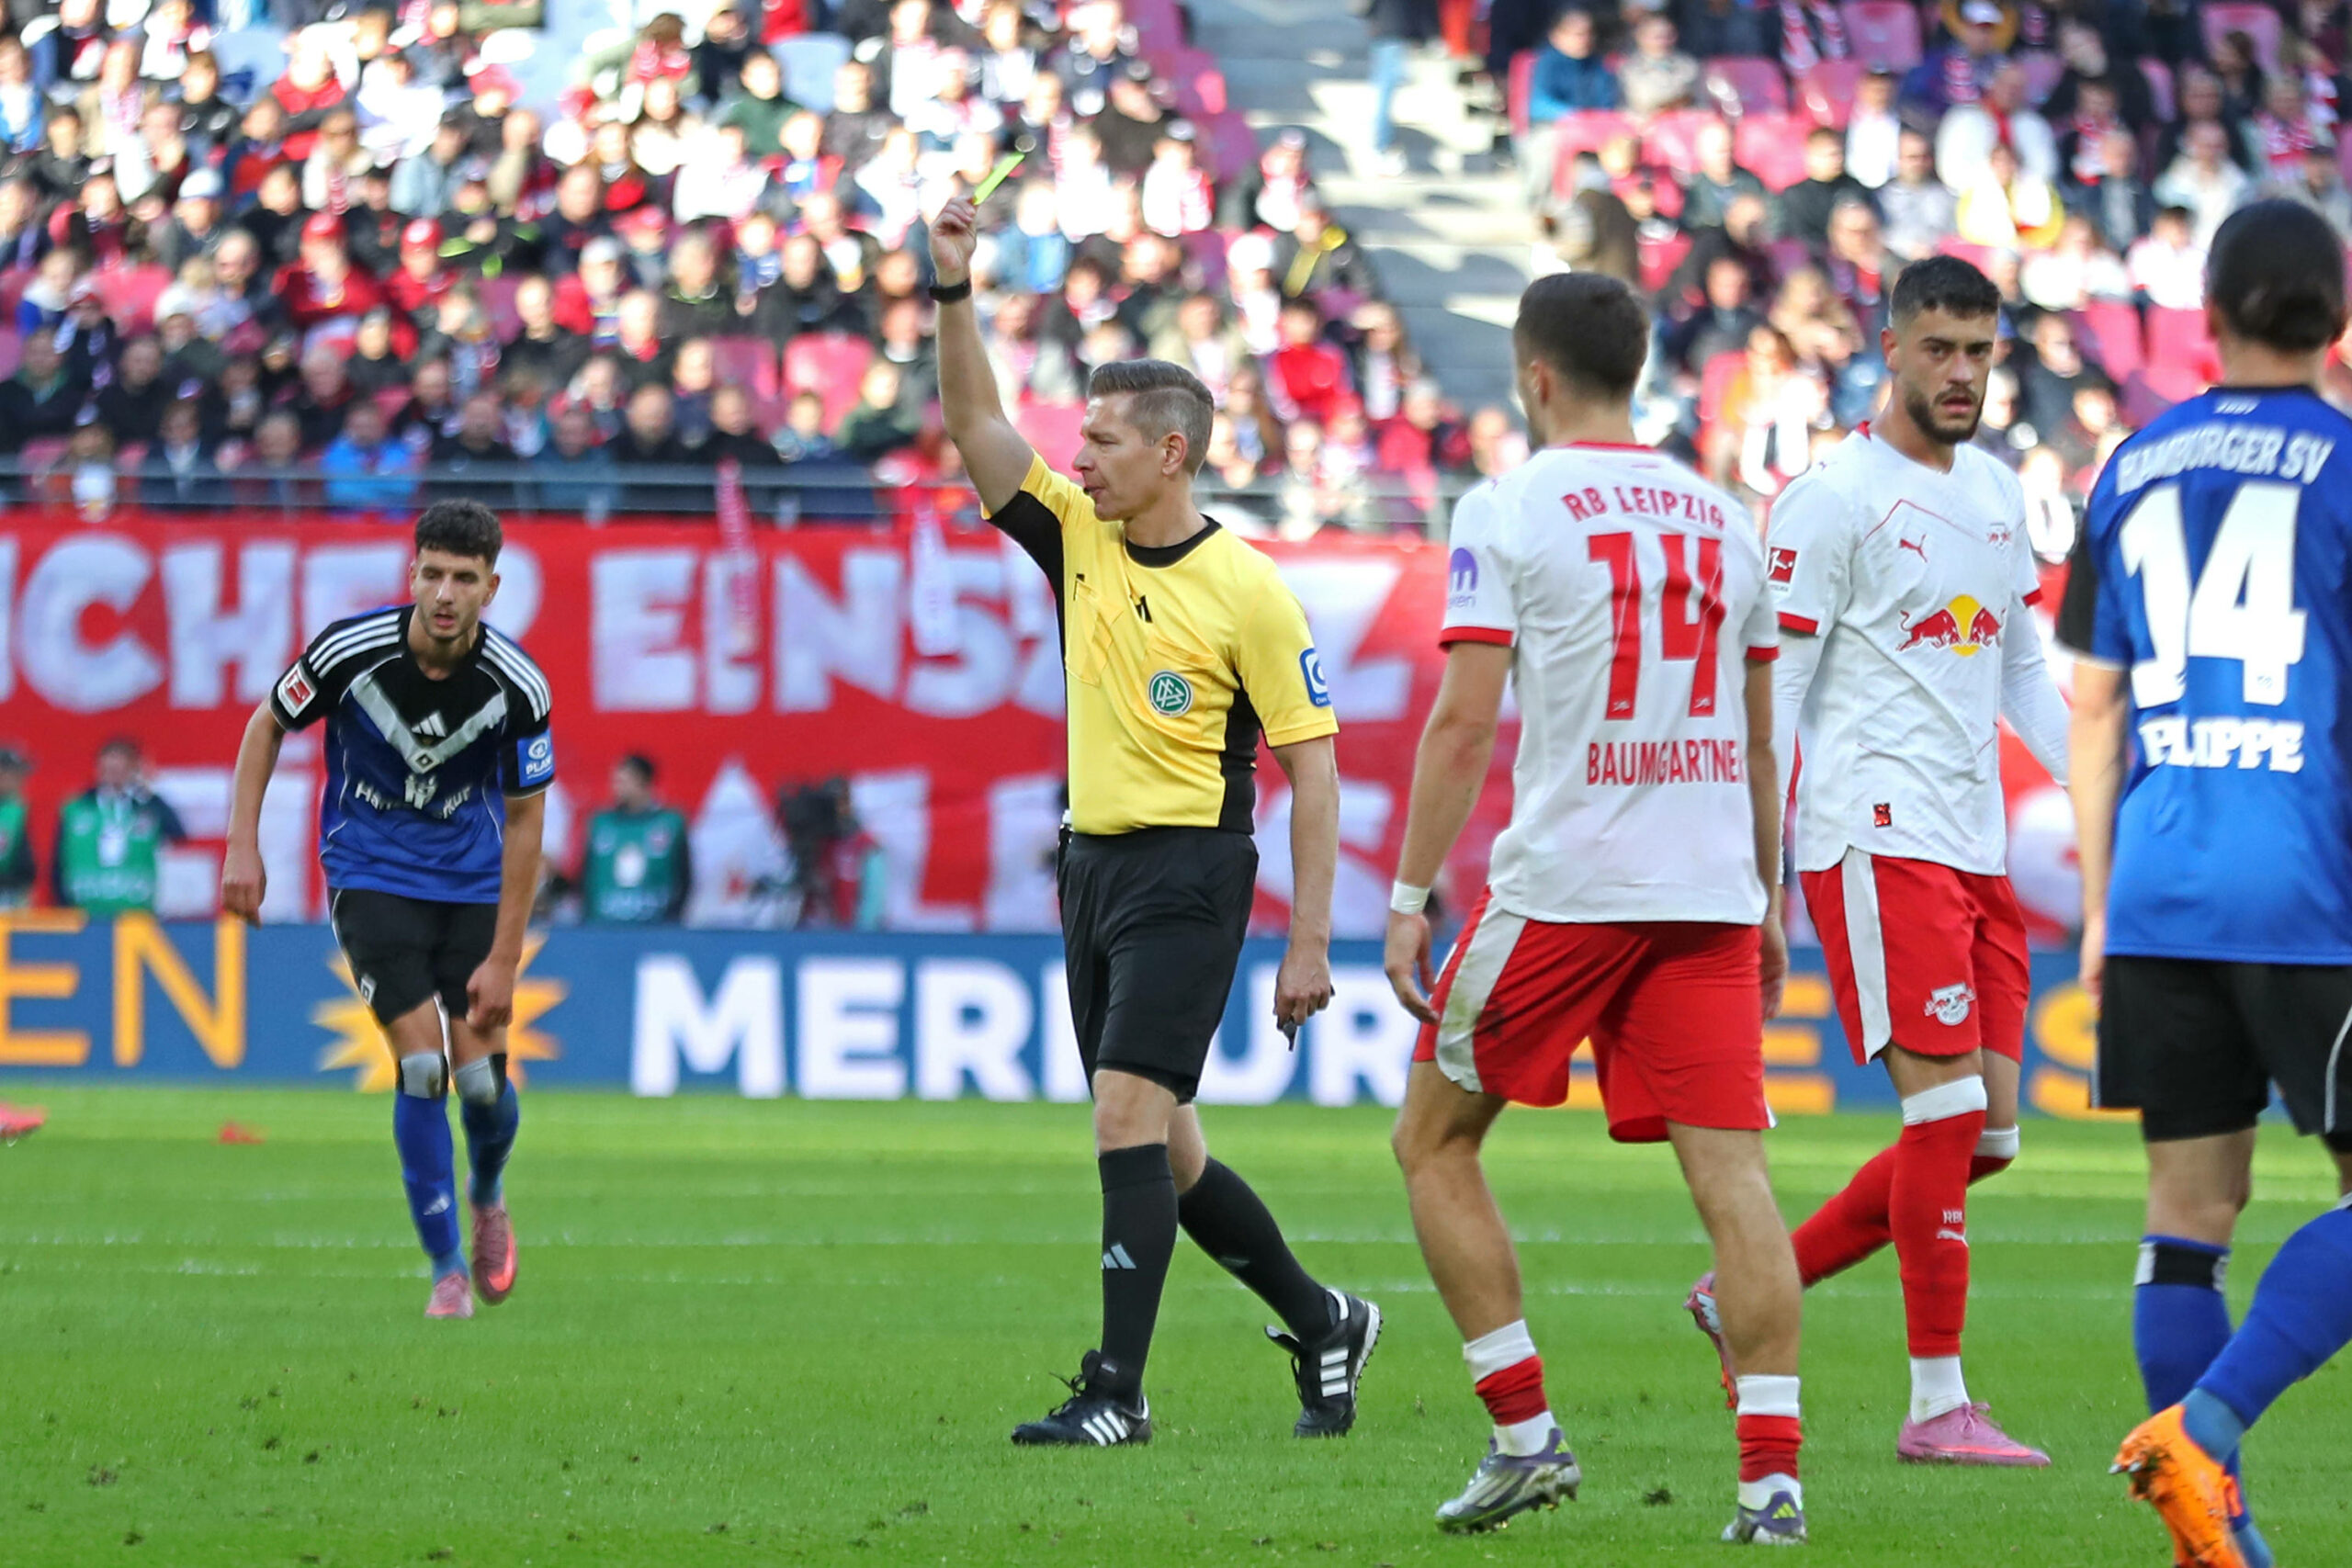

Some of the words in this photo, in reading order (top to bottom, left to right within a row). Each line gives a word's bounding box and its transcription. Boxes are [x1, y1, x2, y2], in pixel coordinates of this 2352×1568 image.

[1561, 487, 1608, 523] RB
[1613, 486, 1724, 530] LEIPZIG
[2116, 423, 2286, 497] HAMBURGER
[2278, 431, 2335, 485] SV
[1587, 531, 1726, 720] 14
[2119, 482, 2308, 709] 14
[628, 952, 1429, 1105] MERUR
